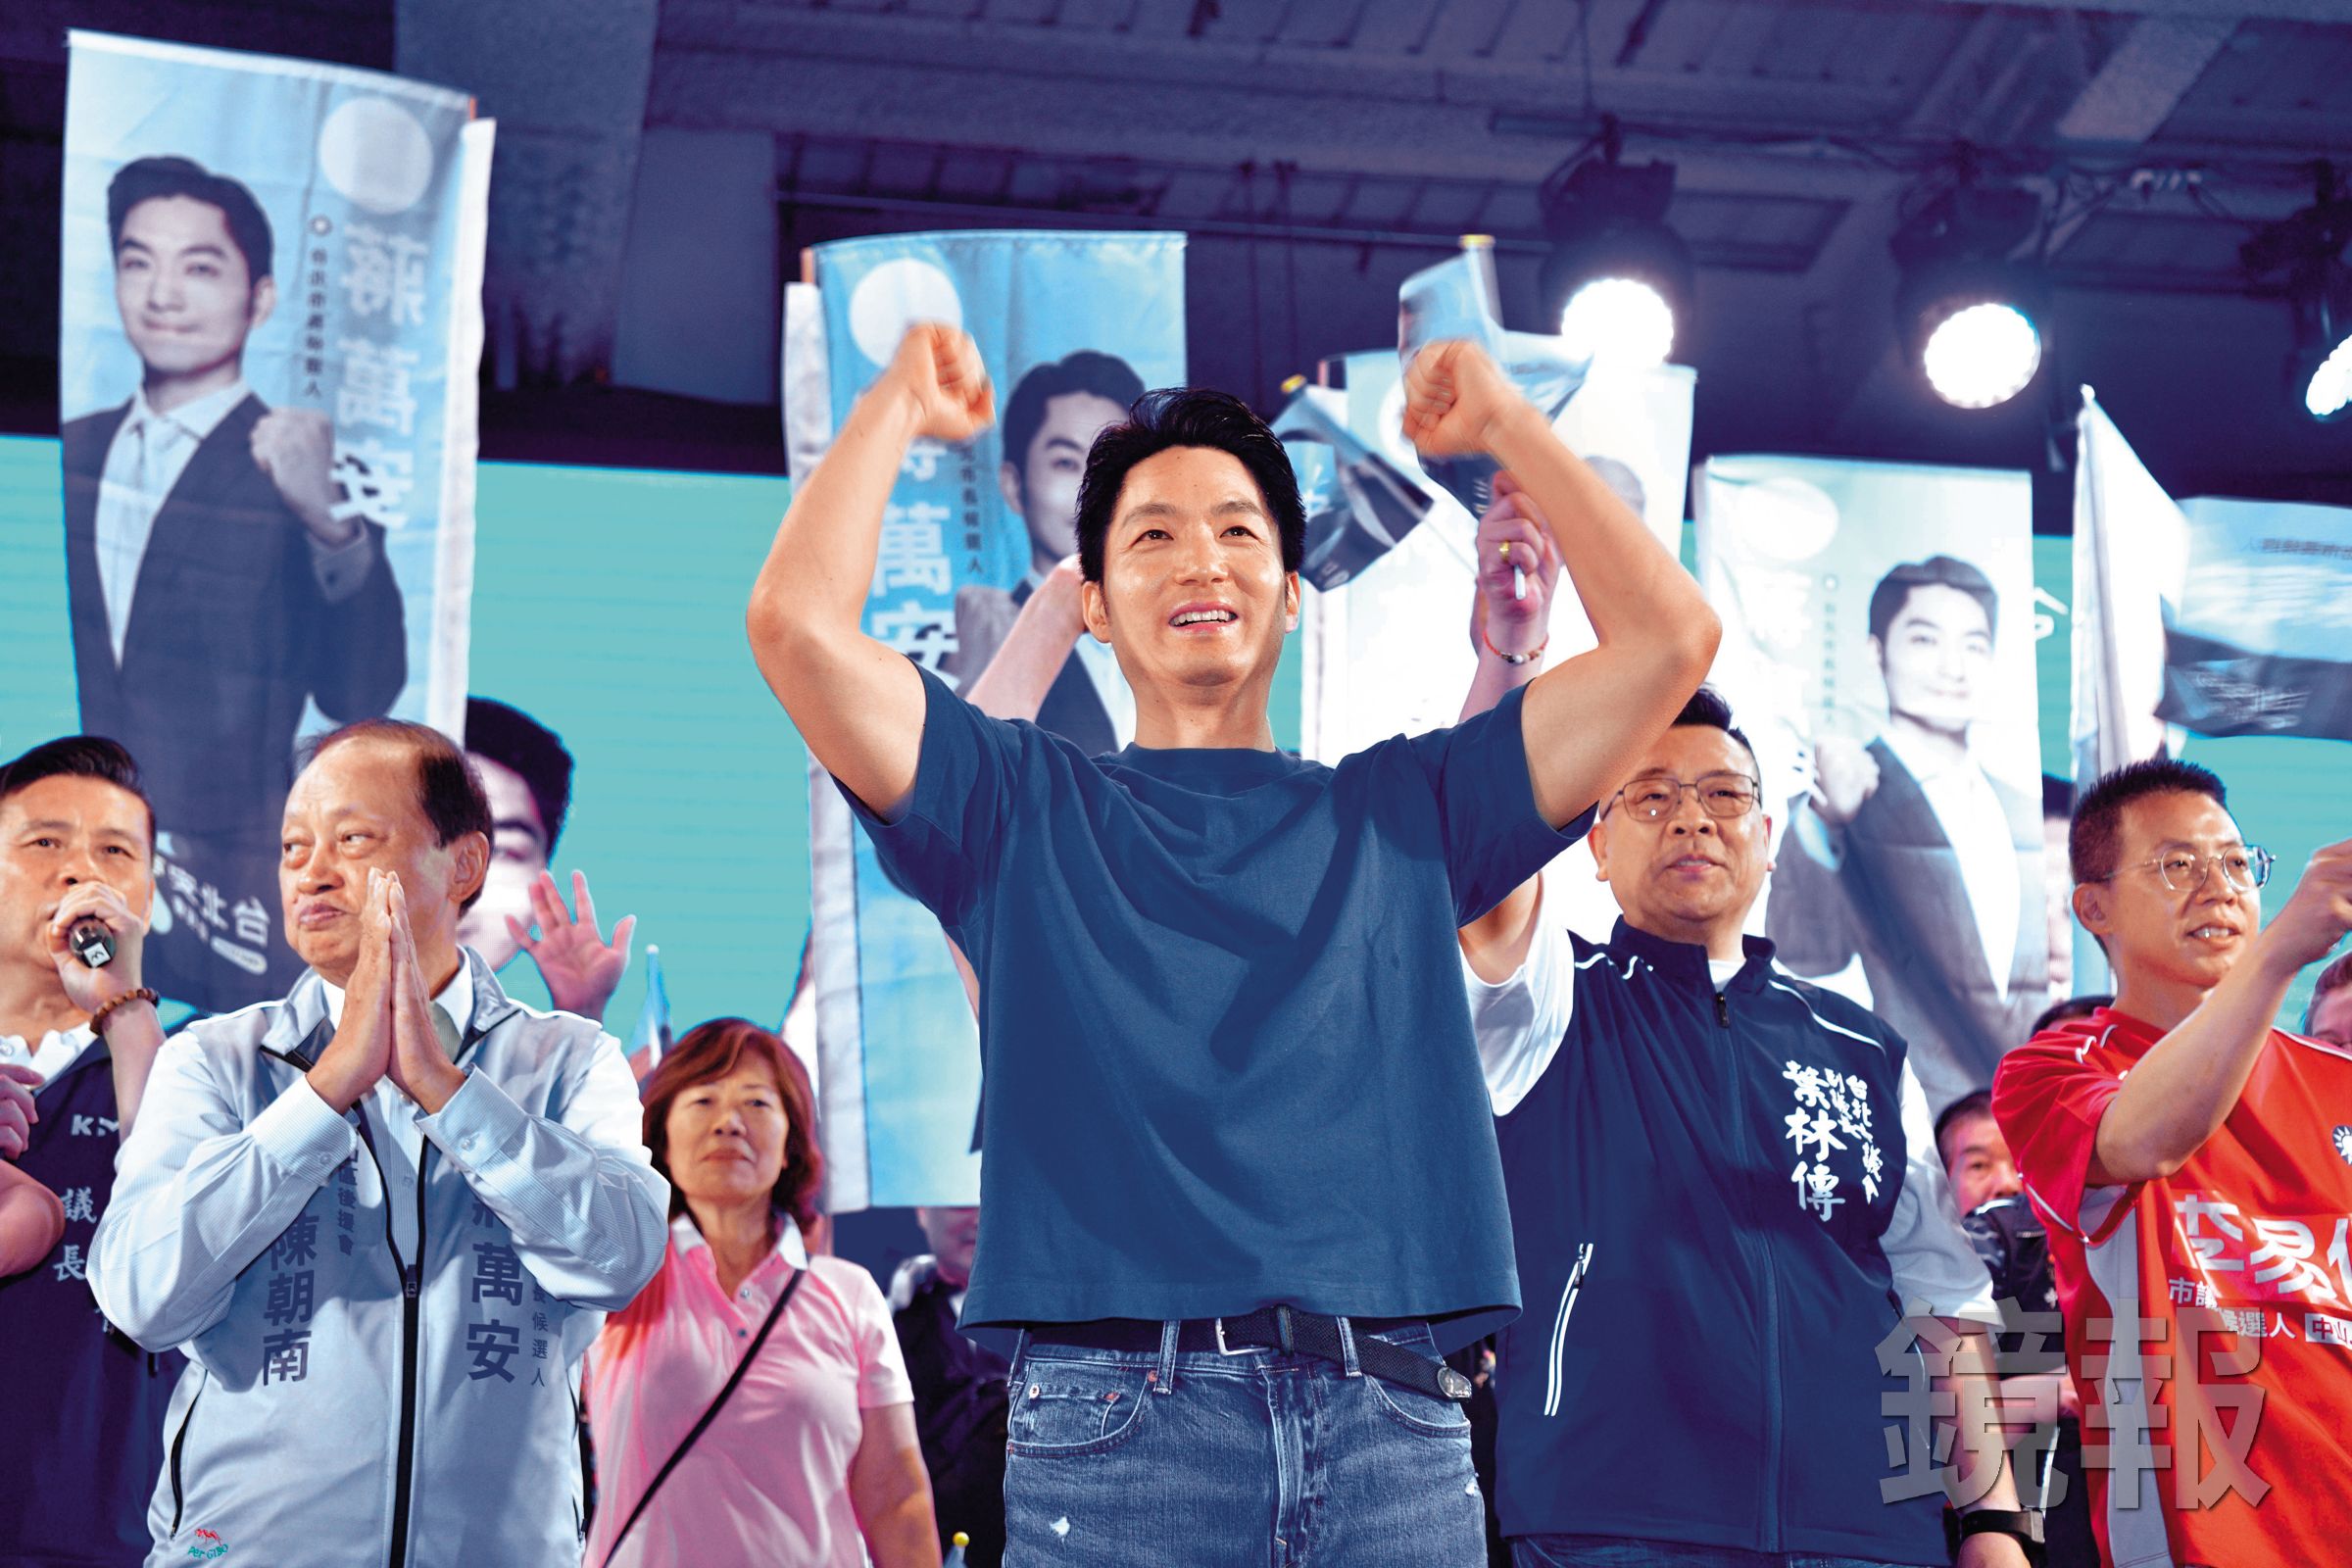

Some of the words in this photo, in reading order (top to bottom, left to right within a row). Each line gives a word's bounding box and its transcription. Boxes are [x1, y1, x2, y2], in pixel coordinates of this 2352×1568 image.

[1782, 1059, 1848, 1222] 葉林傳
[52, 1186, 98, 1282] 議長
[263, 1211, 319, 1387] 陳朝南
[2168, 1276, 2296, 1340] 市議候選人
